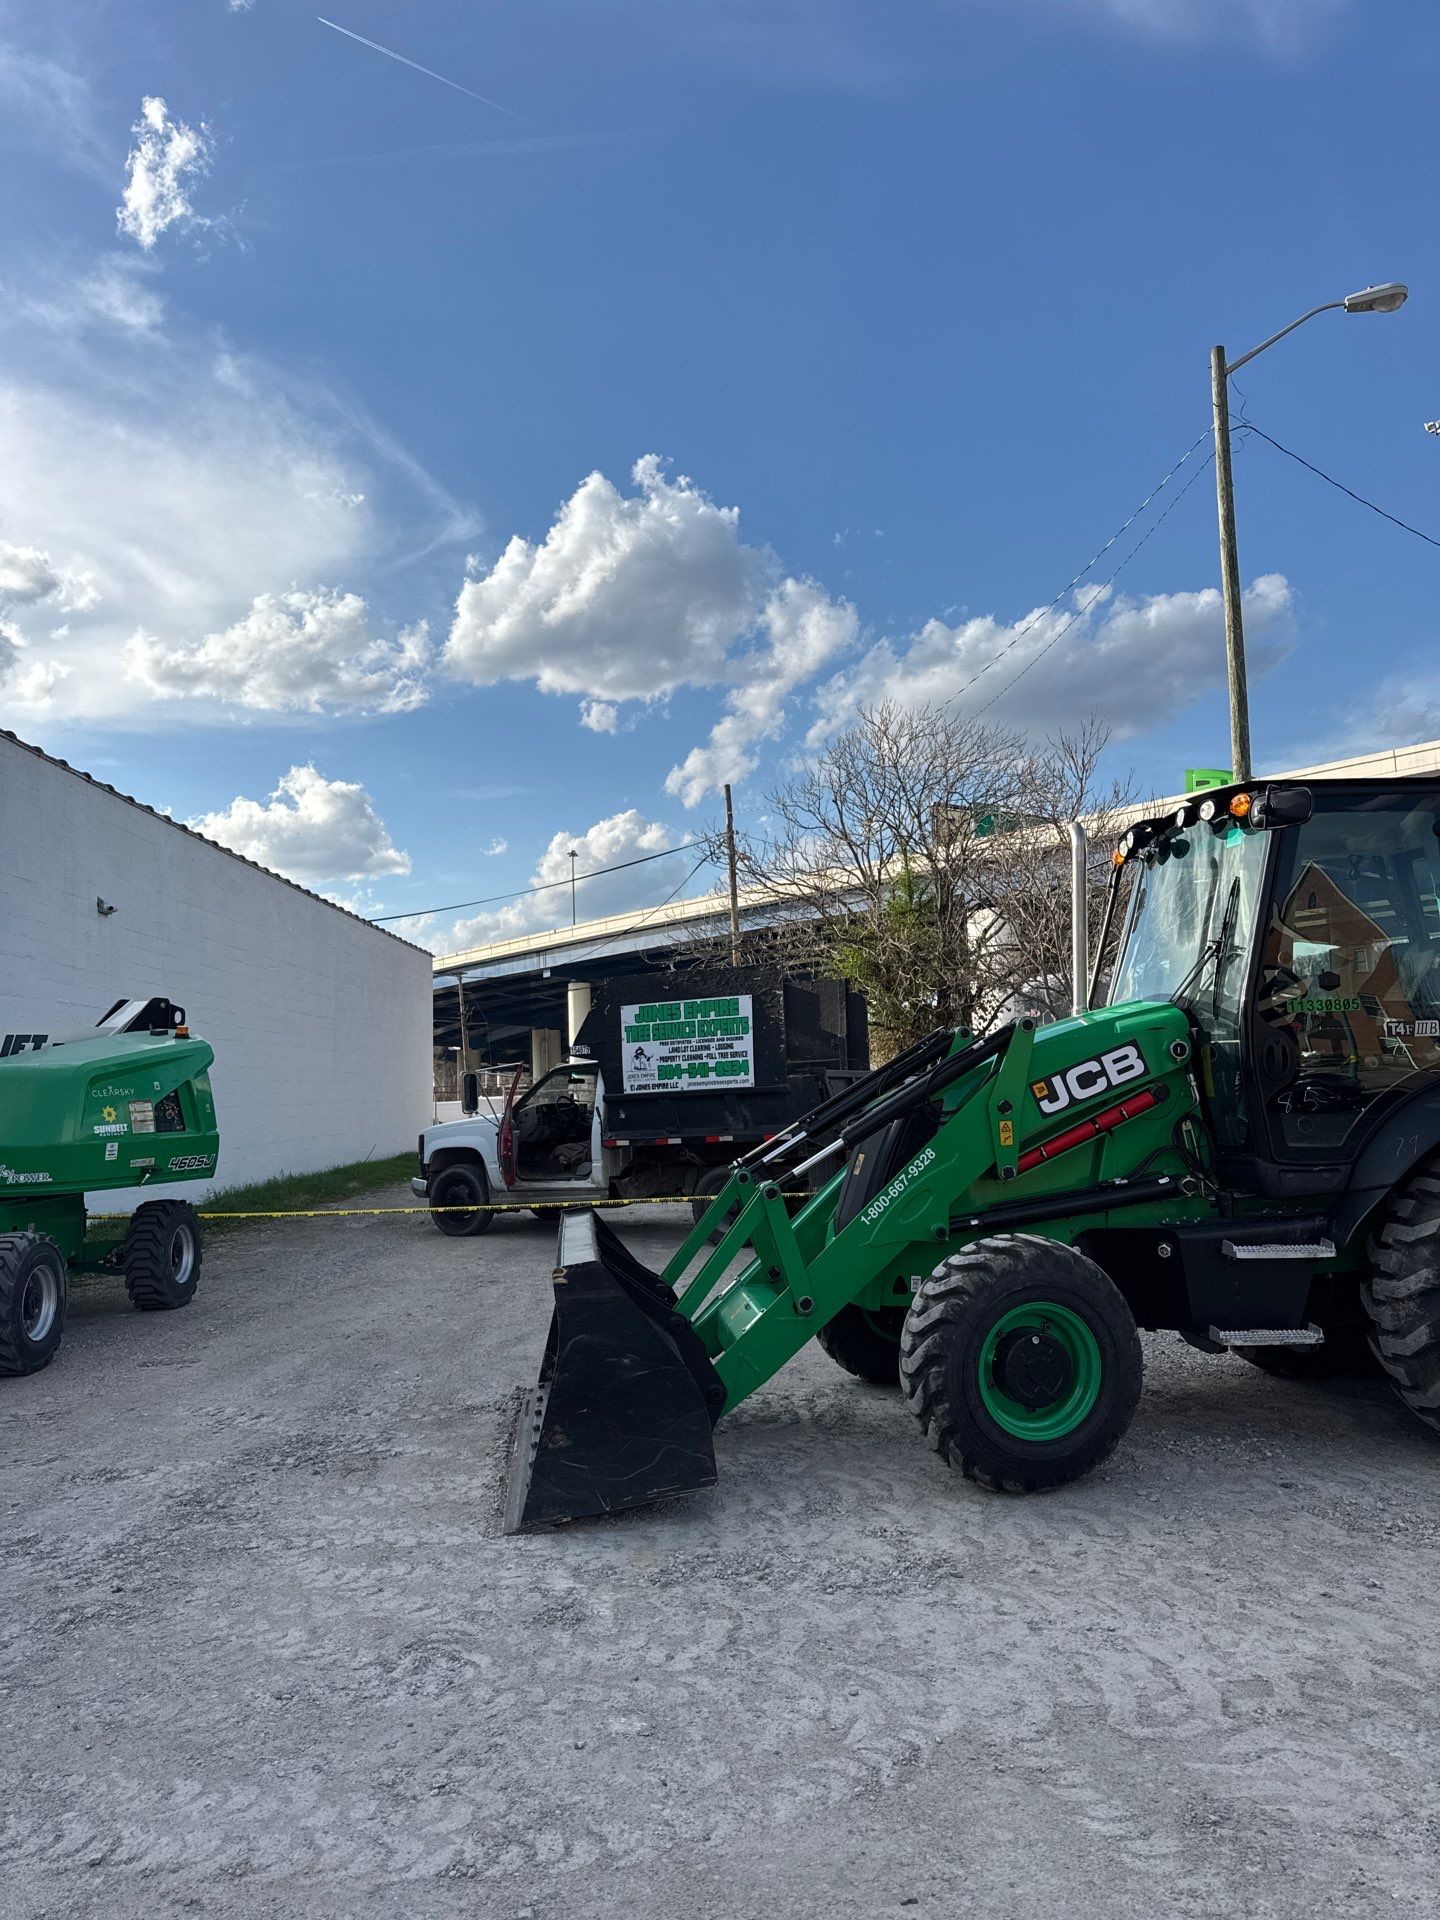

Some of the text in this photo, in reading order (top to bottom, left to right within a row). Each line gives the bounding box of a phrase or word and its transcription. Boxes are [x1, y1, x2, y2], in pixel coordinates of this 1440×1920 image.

[635, 998, 739, 1023] JONES EMPIRE
[1288, 999, 1360, 1012] 11330805
[625, 1017, 749, 1043] TREE SERVICE EXPERTS
[659, 1055, 681, 1063] PROPERTY
[718, 1051, 729, 1059] TREE
[729, 1050, 748, 1058] SERVICE
[669, 1046, 680, 1054] LAND
[652, 1082, 669, 1090] EMPIRE
[1039, 1045, 1145, 1114] JCB
[92, 1088, 134, 1097] CLEARSKY
[94, 1123, 128, 1134] SUNBELT
[168, 1154, 216, 1171] 460SJ
[860, 1148, 936, 1225] 1-800-667-9328
